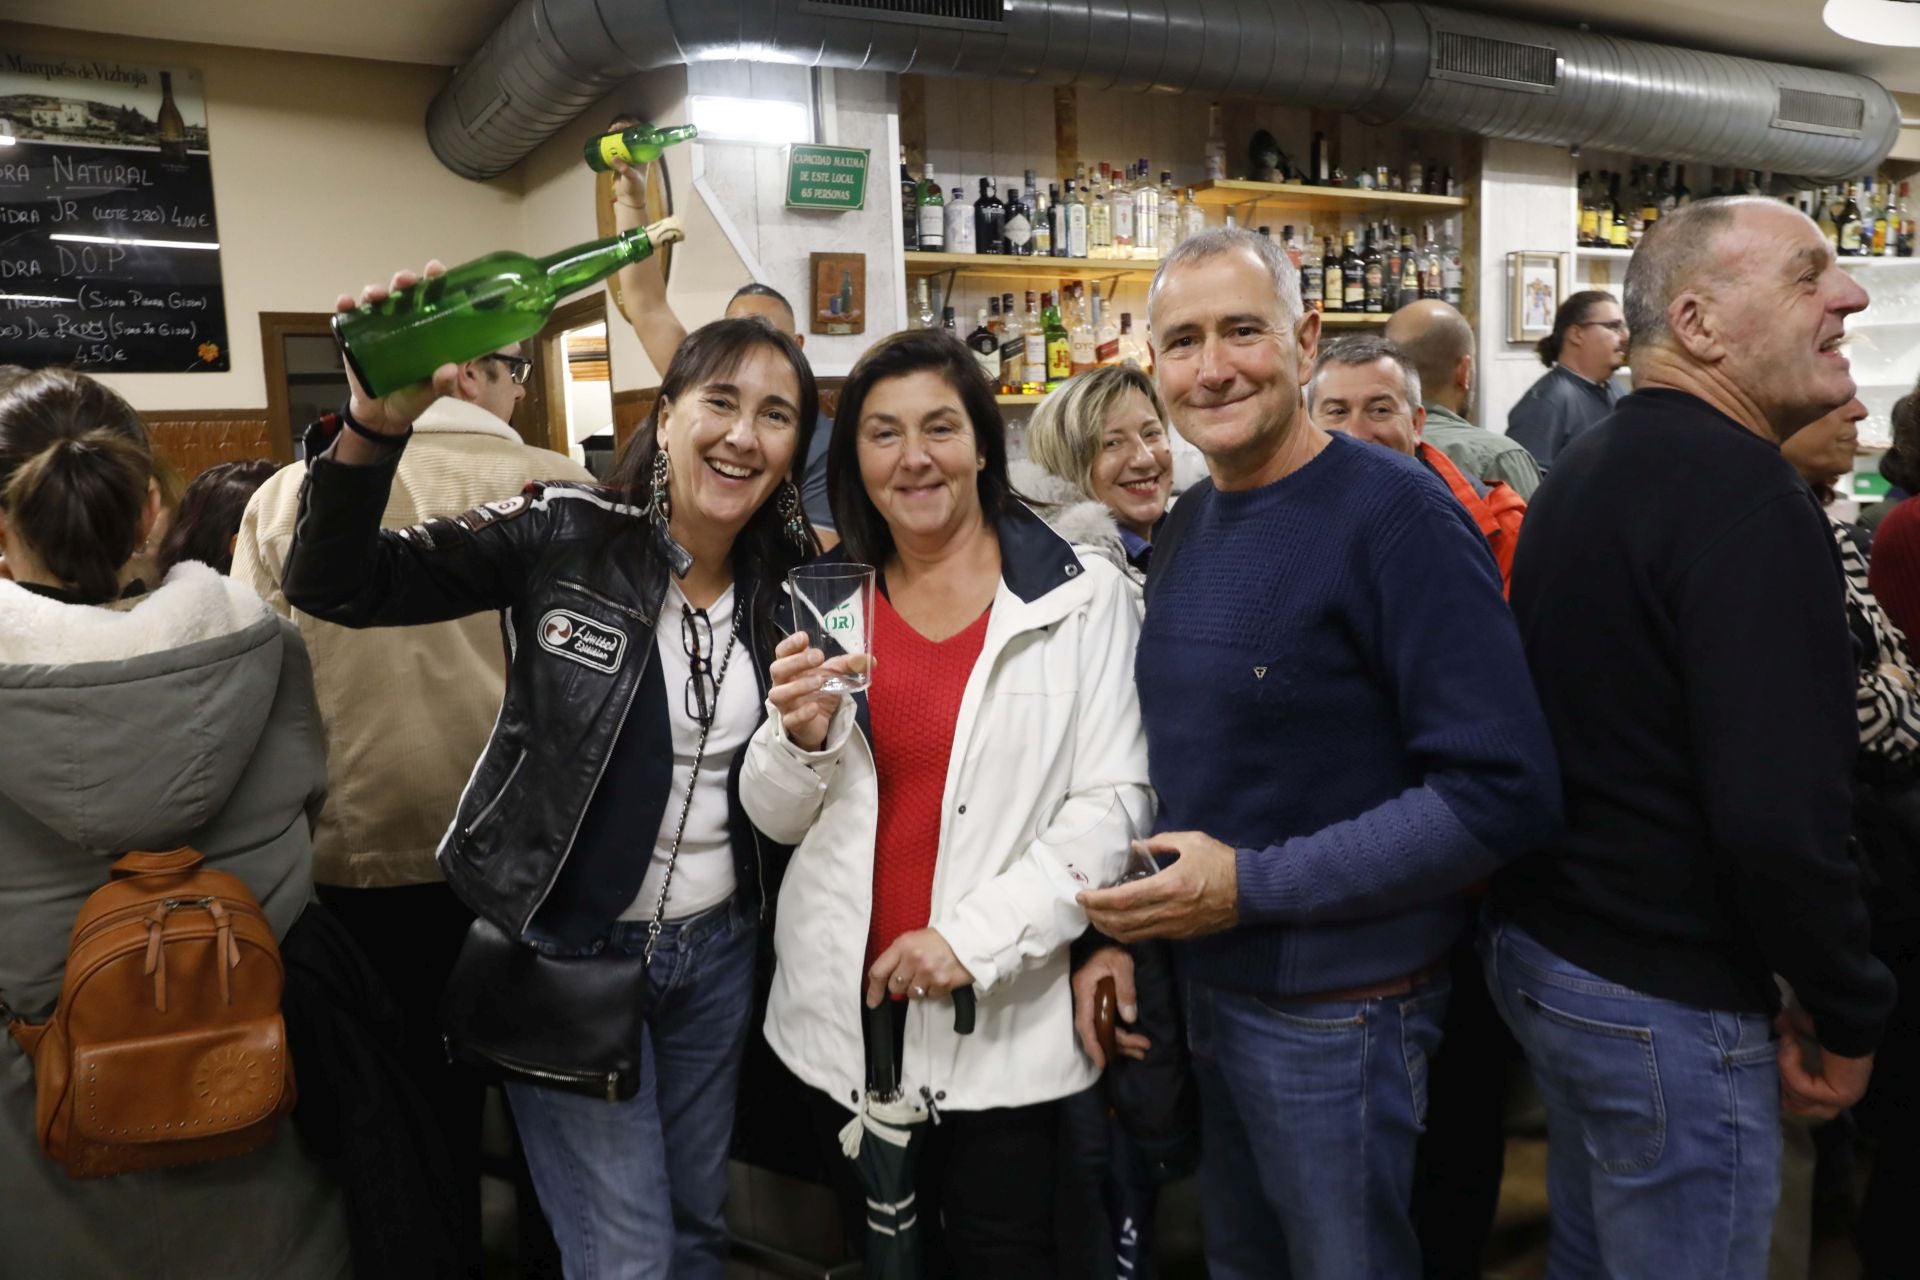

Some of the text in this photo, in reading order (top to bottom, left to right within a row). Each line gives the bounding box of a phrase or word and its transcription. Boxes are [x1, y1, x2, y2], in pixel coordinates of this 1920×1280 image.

[6, 53, 148, 88] Marqués de Vizhoja
[800, 171, 855, 184] DE ESTE LOCAL
[801, 187, 850, 200] 65 PERSONAS
[47, 196, 79, 221] JR
[572, 624, 617, 652] Limited
